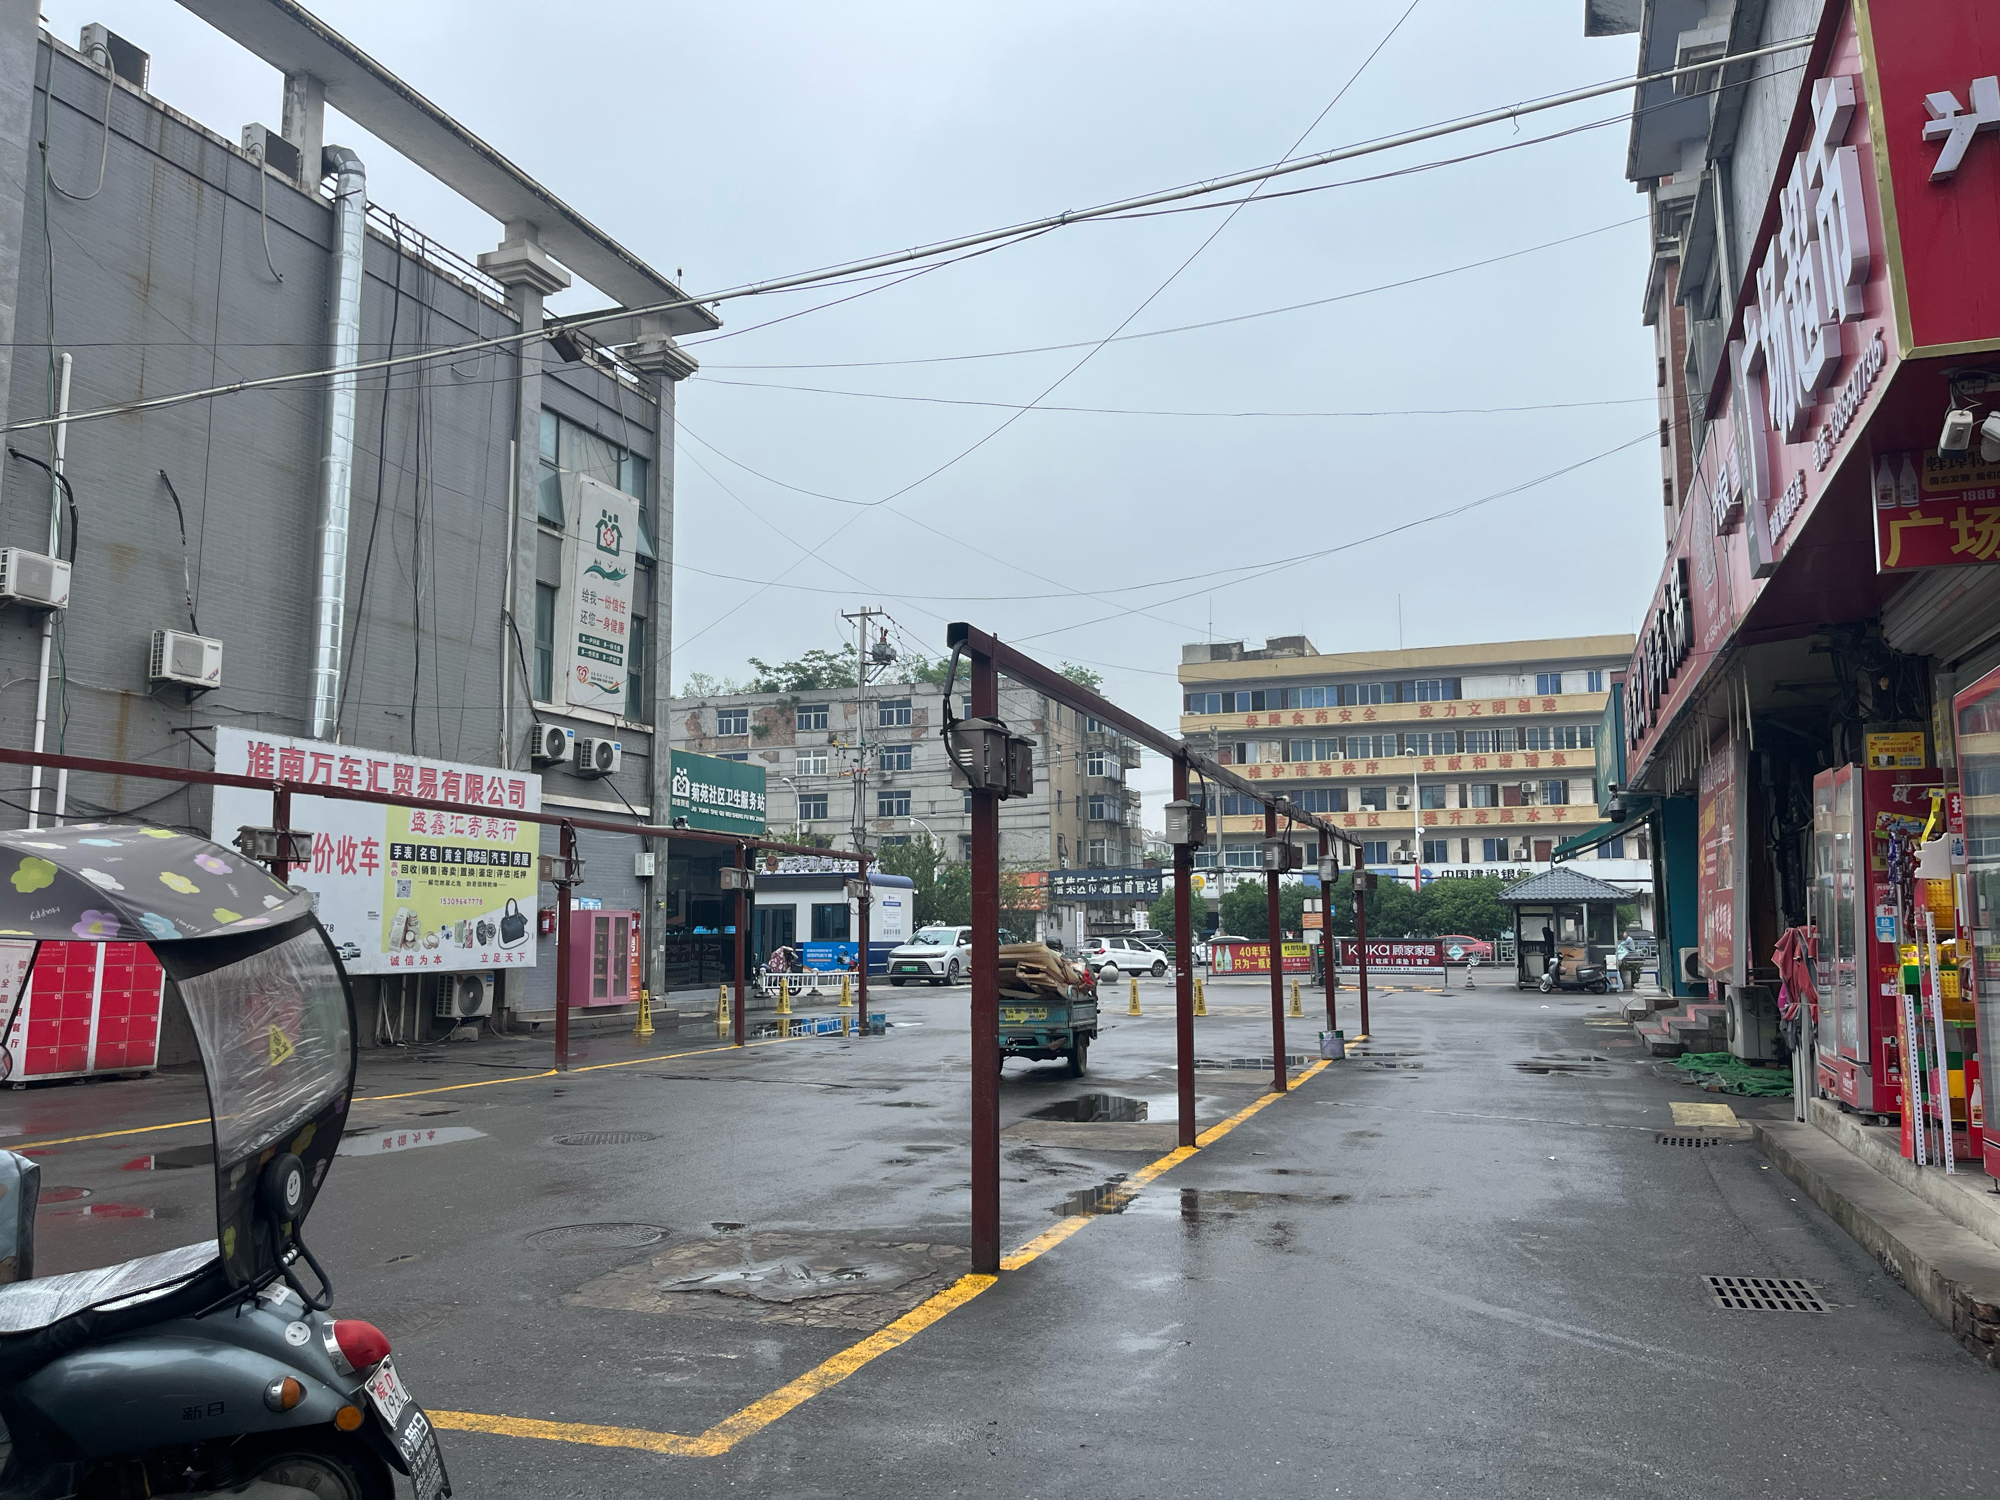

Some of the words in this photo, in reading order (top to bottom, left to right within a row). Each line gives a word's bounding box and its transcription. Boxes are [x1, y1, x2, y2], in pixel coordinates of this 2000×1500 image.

[1962, 489, 1996, 501] 1986
[582, 588, 626, 614] 给我一份信任
[580, 609, 625, 635] 还您一身健康
[1246, 707, 1377, 728] 保障食药安全
[1419, 698, 1557, 719] 致力文明创建
[1248, 761, 1379, 779] 维护市场秩序
[1423, 752, 1566, 772] 贡献和谐潘集
[246, 741, 526, 809] 淮南万车汇贸易有限公司
[691, 782, 765, 812] 菊苑社区卫生服务站
[1423, 808, 1567, 826] 提升发展水平
[393, 845, 412, 859] 手表
[420, 847, 438, 861] 名包
[444, 848, 462, 862] 黄金
[466, 850, 487, 864] 奢侈品
[491, 850, 507, 864] 汽车
[513, 852, 529, 866] 房屋
[391, 861, 398, 877] 高价
[401, 864, 417, 875] 回收
[421, 865, 437, 876] 销售
[441, 866, 456, 876] 寄卖
[460, 867, 475, 877] 置换
[496, 869, 510, 879] 评估
[1883, 907, 1894, 915] 推
[1881, 918, 1890, 926] 拉
[390, 954, 442, 966] 诚信为本
[480, 952, 525, 963] 立足天下
[1239, 946, 1270, 957] 40年坚
[1392, 944, 1435, 956] 顾家家居
[376, 1373, 394, 1400] 皖D
[182, 1401, 224, 1420] 新日
